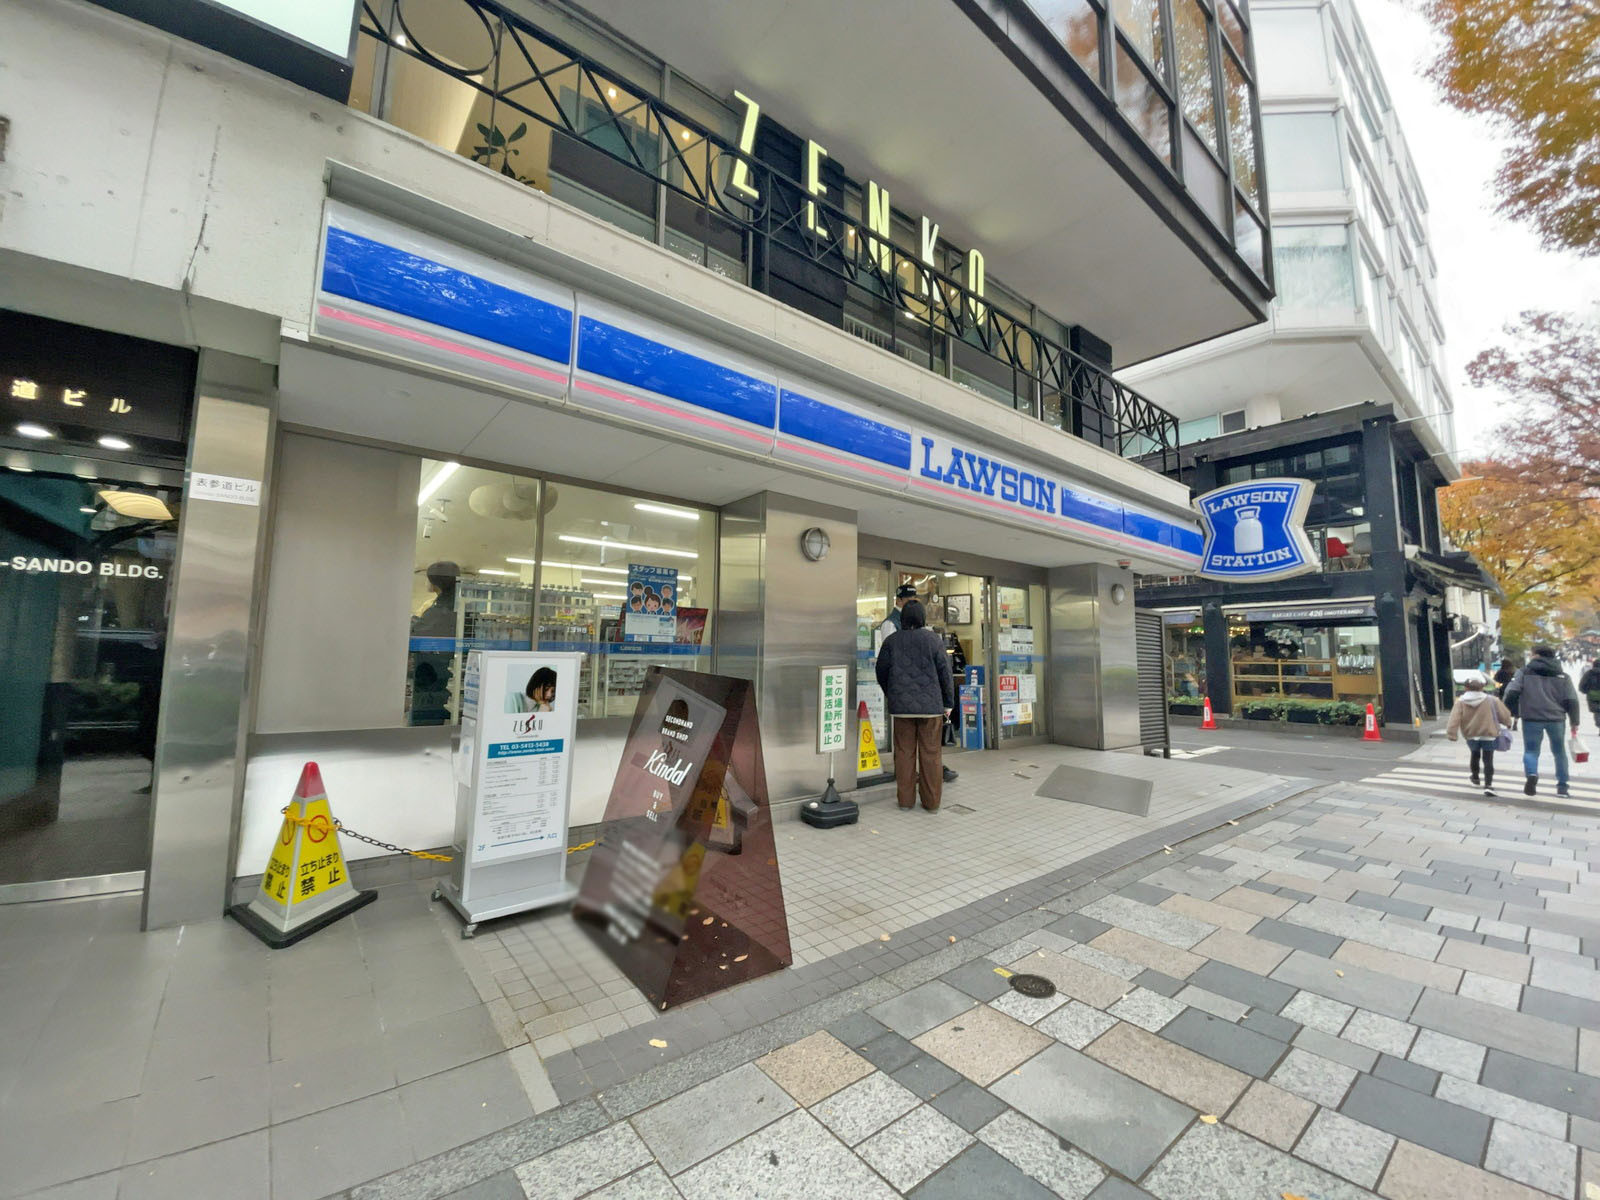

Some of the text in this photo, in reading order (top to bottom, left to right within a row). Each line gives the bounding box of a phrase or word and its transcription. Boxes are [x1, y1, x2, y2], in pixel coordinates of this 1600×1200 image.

[732, 90, 985, 325] ZENKO
[11, 379, 132, 414] 道ビル
[196, 477, 257, 493] 表参道ビル
[920, 437, 1056, 513] LAWSON
[1208, 490, 1289, 514] LAWSON
[1211, 546, 1293, 567] STATION
[100, 564, 164, 580] BLDG.
[1000, 677, 1016, 685] ATM
[824, 675, 833, 744] 営業活動禁止
[833, 675, 844, 743] この場所での
[661, 727, 676, 739] BRAND
[665, 715, 694, 729] SECONDHAND
[643, 749, 693, 786] Kindal
[652, 789, 664, 800] BUY
[646, 810, 659, 823] SELL
[301, 852, 339, 876] 立ち止まり
[301, 868, 341, 896] 禁止
